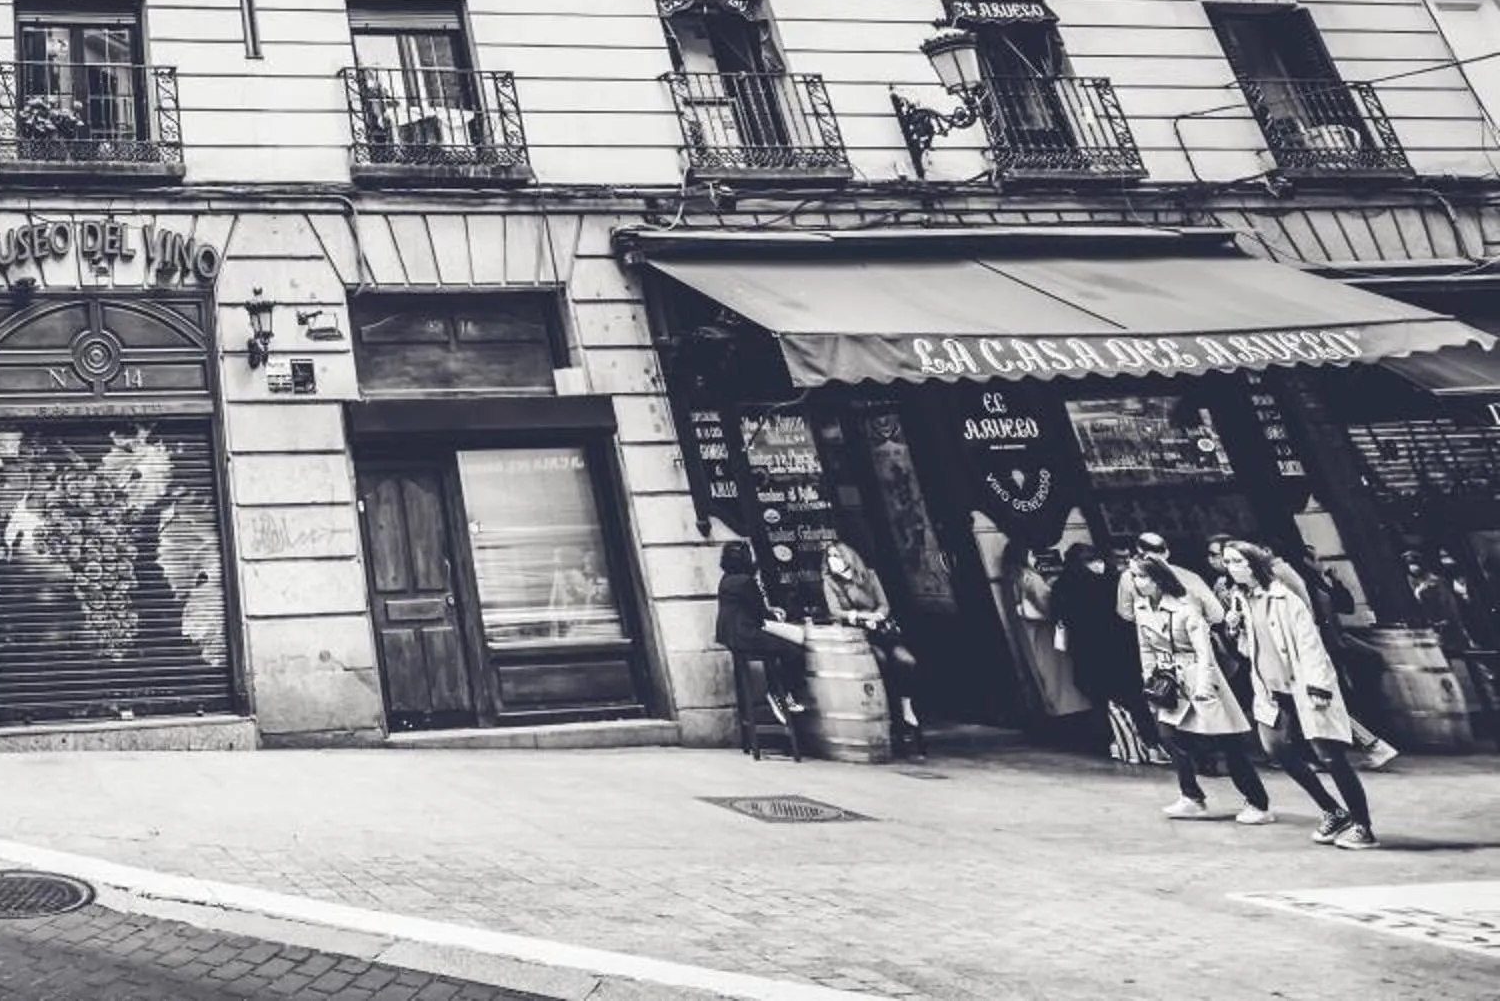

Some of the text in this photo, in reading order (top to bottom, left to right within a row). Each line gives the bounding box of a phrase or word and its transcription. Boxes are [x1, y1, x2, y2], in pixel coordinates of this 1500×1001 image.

[979, 1, 1045, 17] ABUELO
[81, 220, 137, 261] DEL
[140, 224, 222, 280] VINO
[914, 329, 1364, 375] LA CASA DEL ABUELO
[124, 367, 144, 388] 14
[983, 392, 1007, 414] EL
[964, 417, 1039, 439] ABUELO
[986, 468, 1051, 511] VINO GENEROSO
